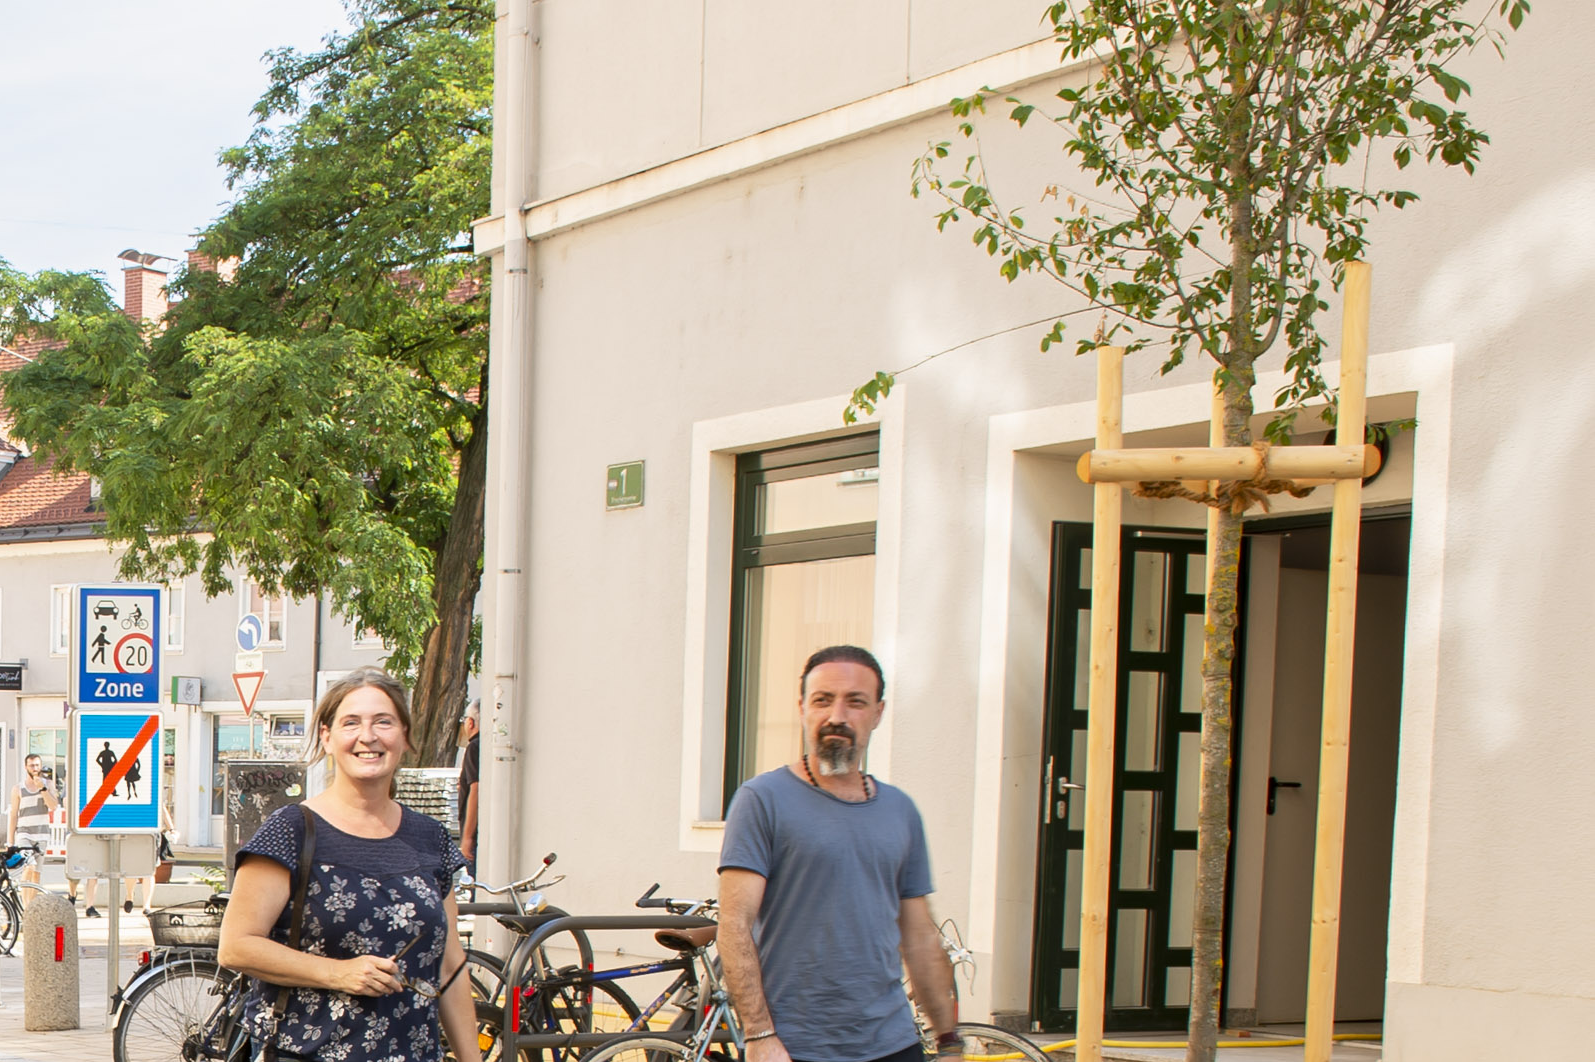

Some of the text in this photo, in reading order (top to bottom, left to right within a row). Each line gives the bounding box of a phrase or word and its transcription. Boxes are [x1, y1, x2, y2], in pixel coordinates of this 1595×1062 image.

[620, 468, 628, 496] 1
[125, 645, 148, 667] 20
[94, 678, 144, 698] Zone
